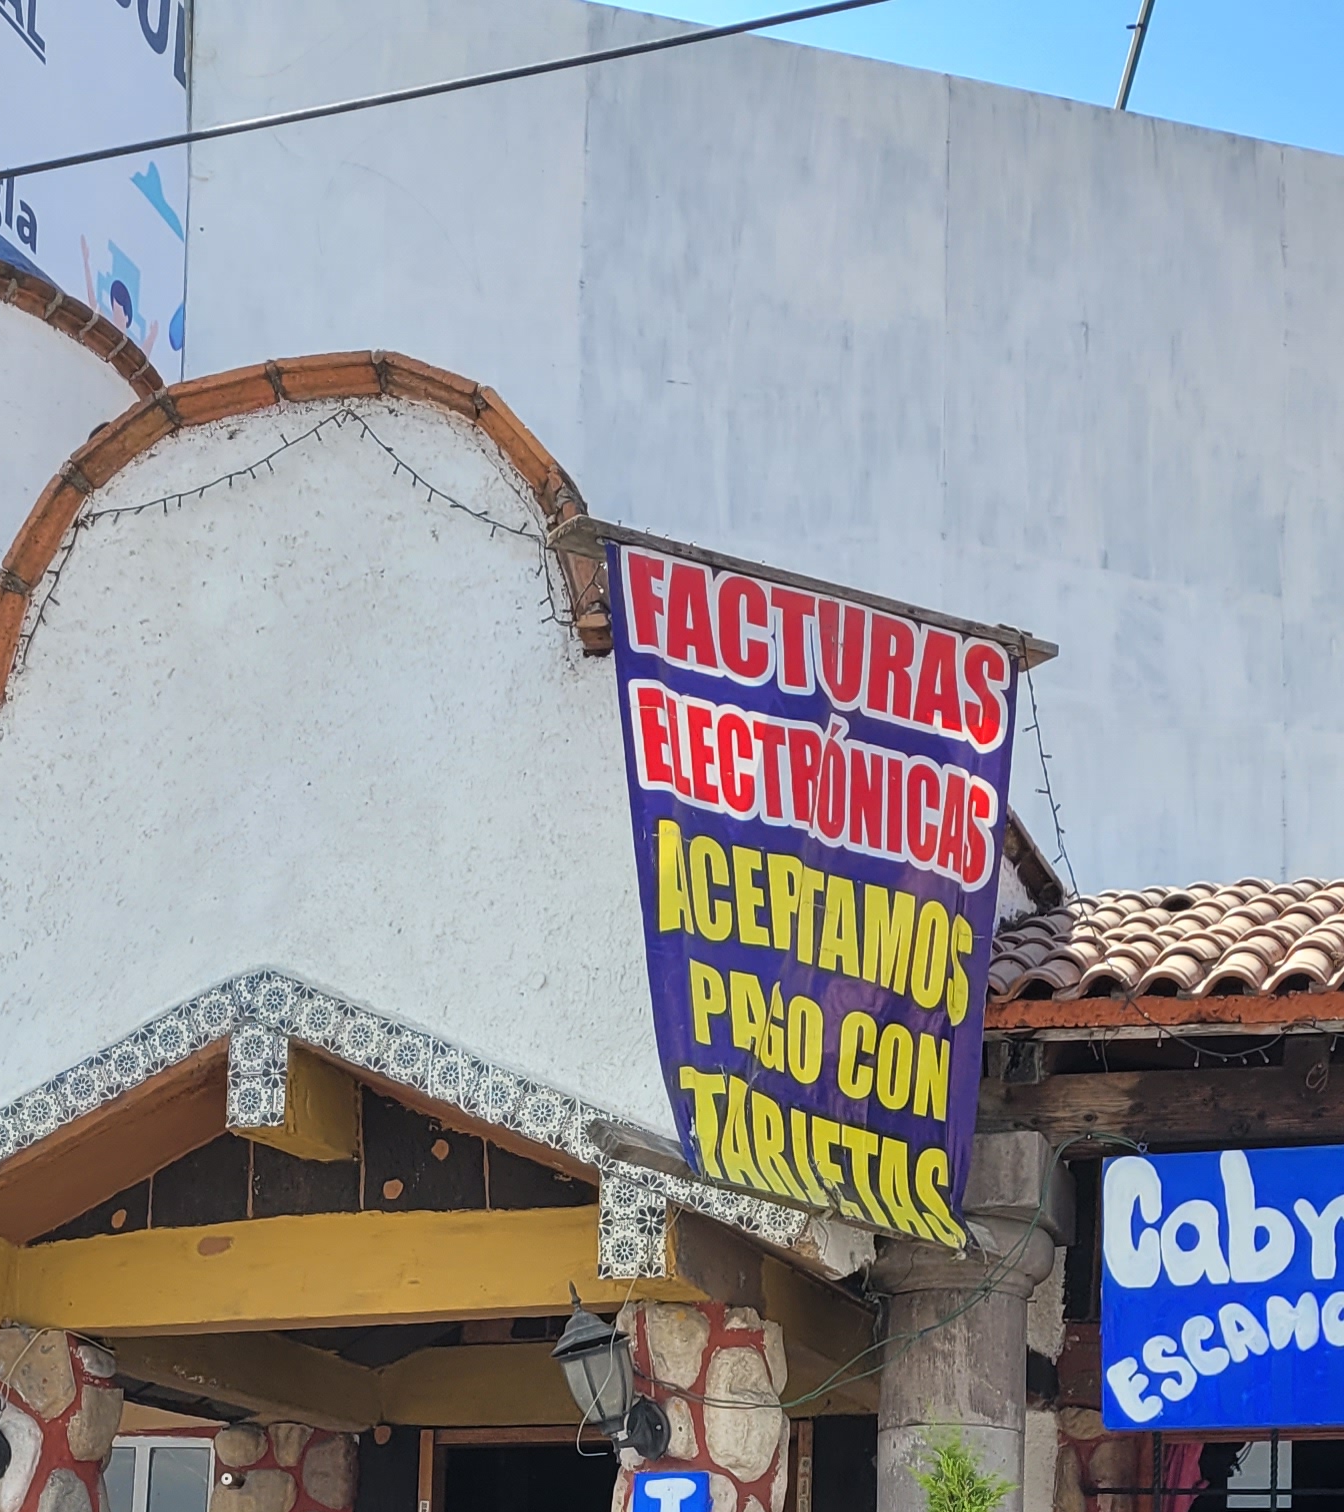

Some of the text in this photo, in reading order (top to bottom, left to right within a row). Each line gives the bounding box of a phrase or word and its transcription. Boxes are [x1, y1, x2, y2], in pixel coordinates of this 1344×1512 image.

[624, 548, 1008, 748] FACTURAS
[633, 684, 993, 887] ELECTRÓNICAS
[659, 819, 973, 1027] ACEPTAMOS
[689, 959, 950, 1122] PAGO CON
